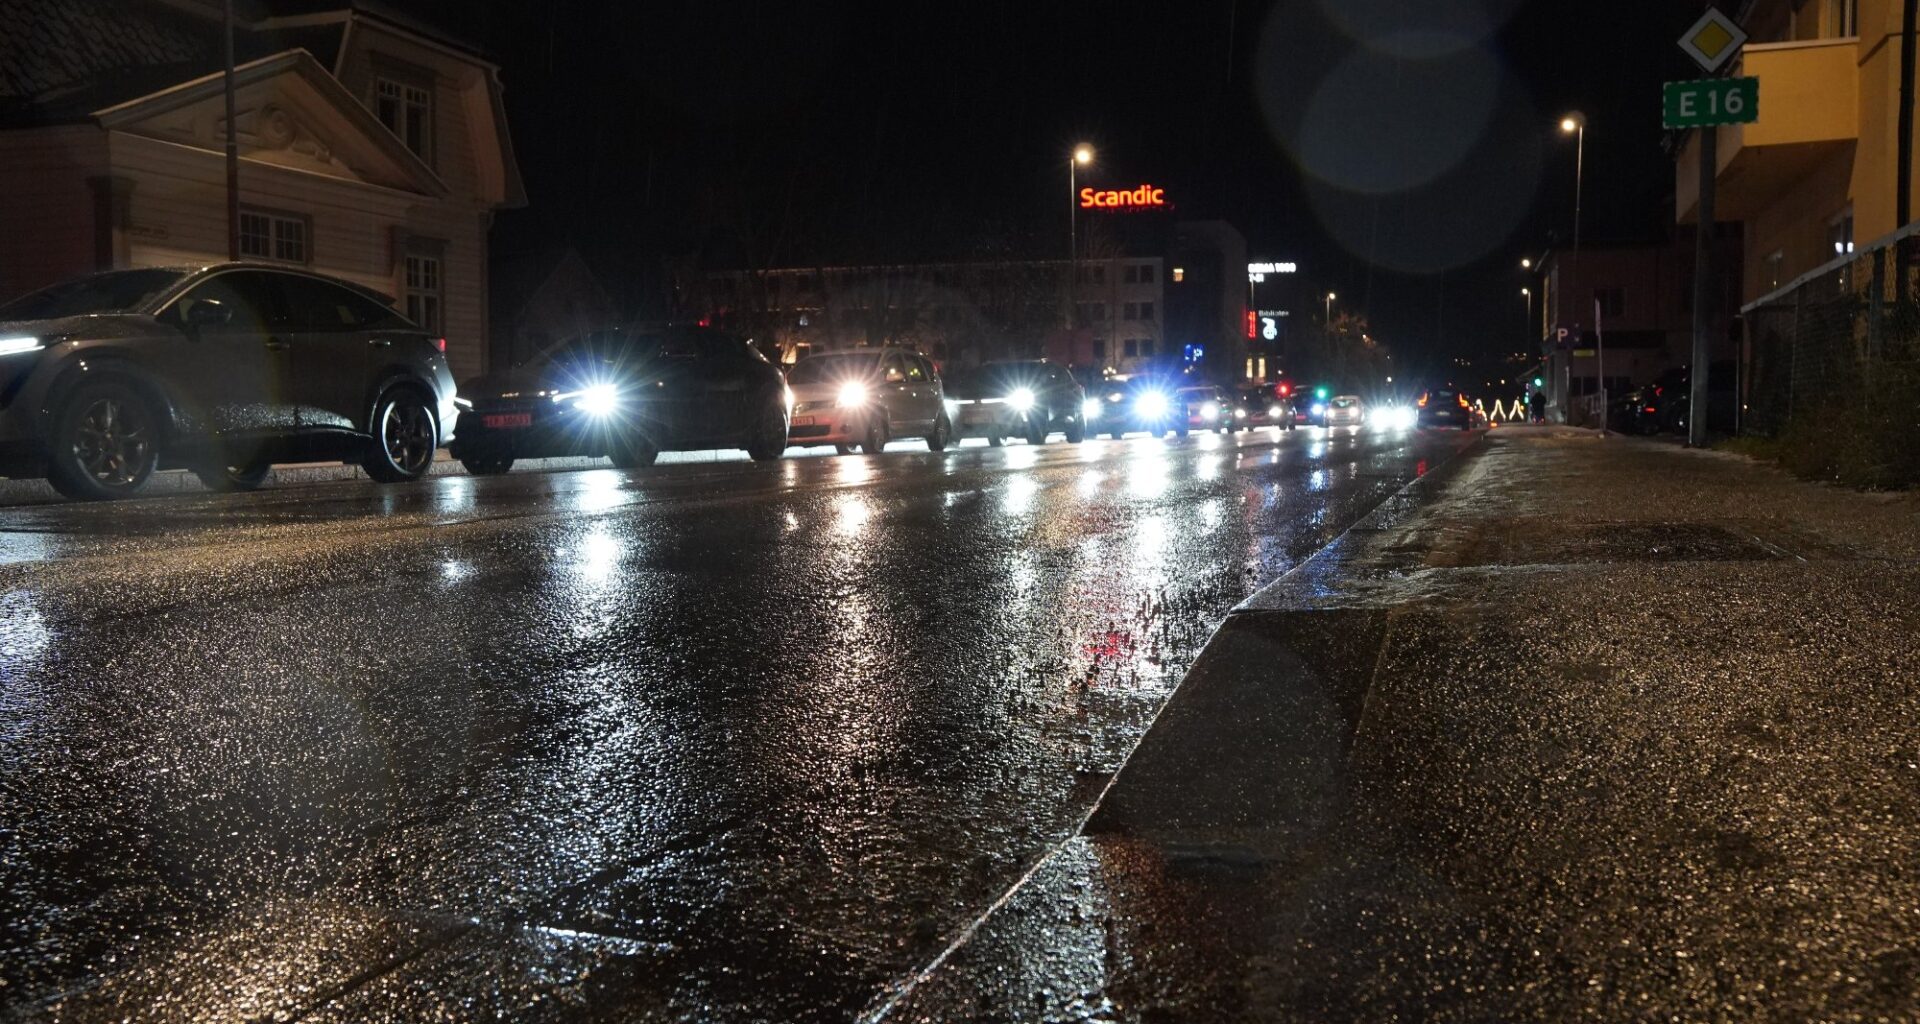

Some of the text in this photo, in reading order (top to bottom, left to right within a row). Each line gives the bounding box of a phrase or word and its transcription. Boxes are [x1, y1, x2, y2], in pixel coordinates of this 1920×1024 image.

[1680, 88, 1744, 117] E 16
[1080, 184, 1164, 207] Scandic
[1557, 328, 1568, 343] P
